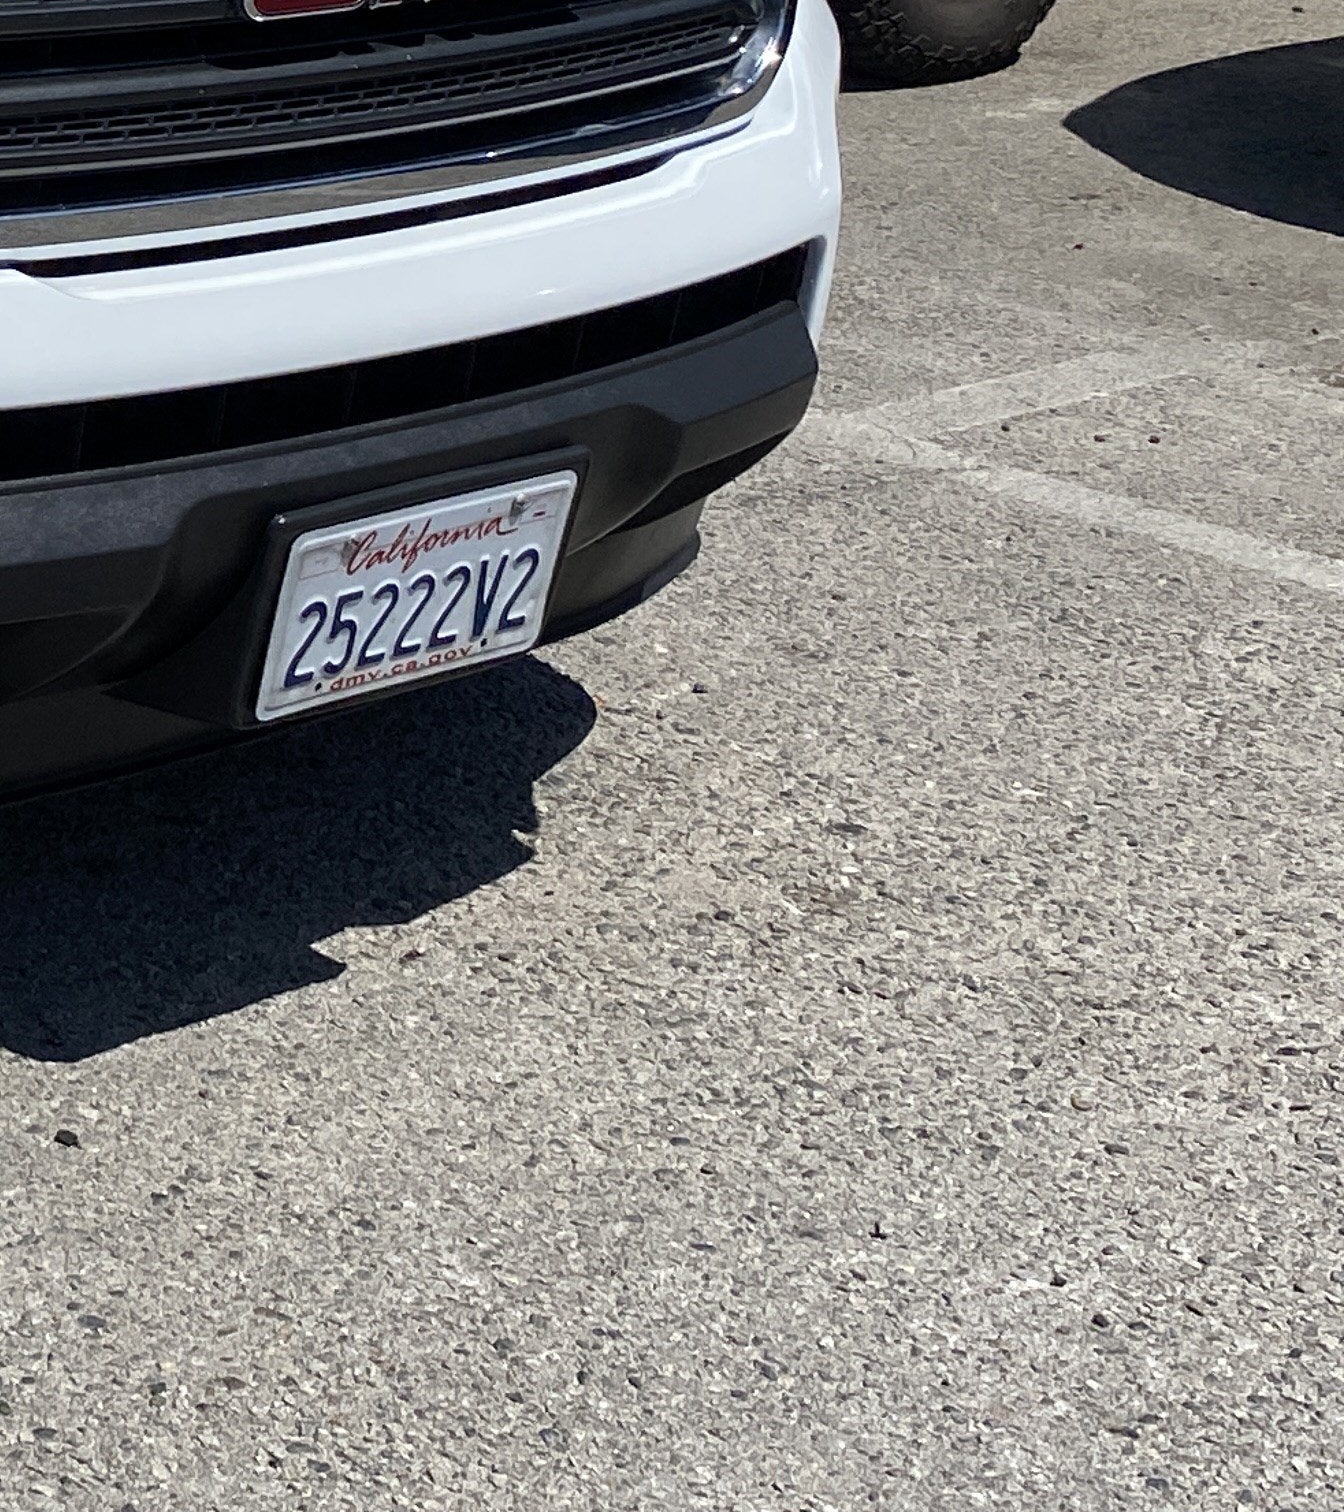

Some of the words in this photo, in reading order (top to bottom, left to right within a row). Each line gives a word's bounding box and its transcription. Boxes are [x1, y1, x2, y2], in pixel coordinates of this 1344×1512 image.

[346, 515, 519, 576] California
[283, 546, 541, 690] 25222V2
[330, 645, 473, 693] dmv.ca.gov
